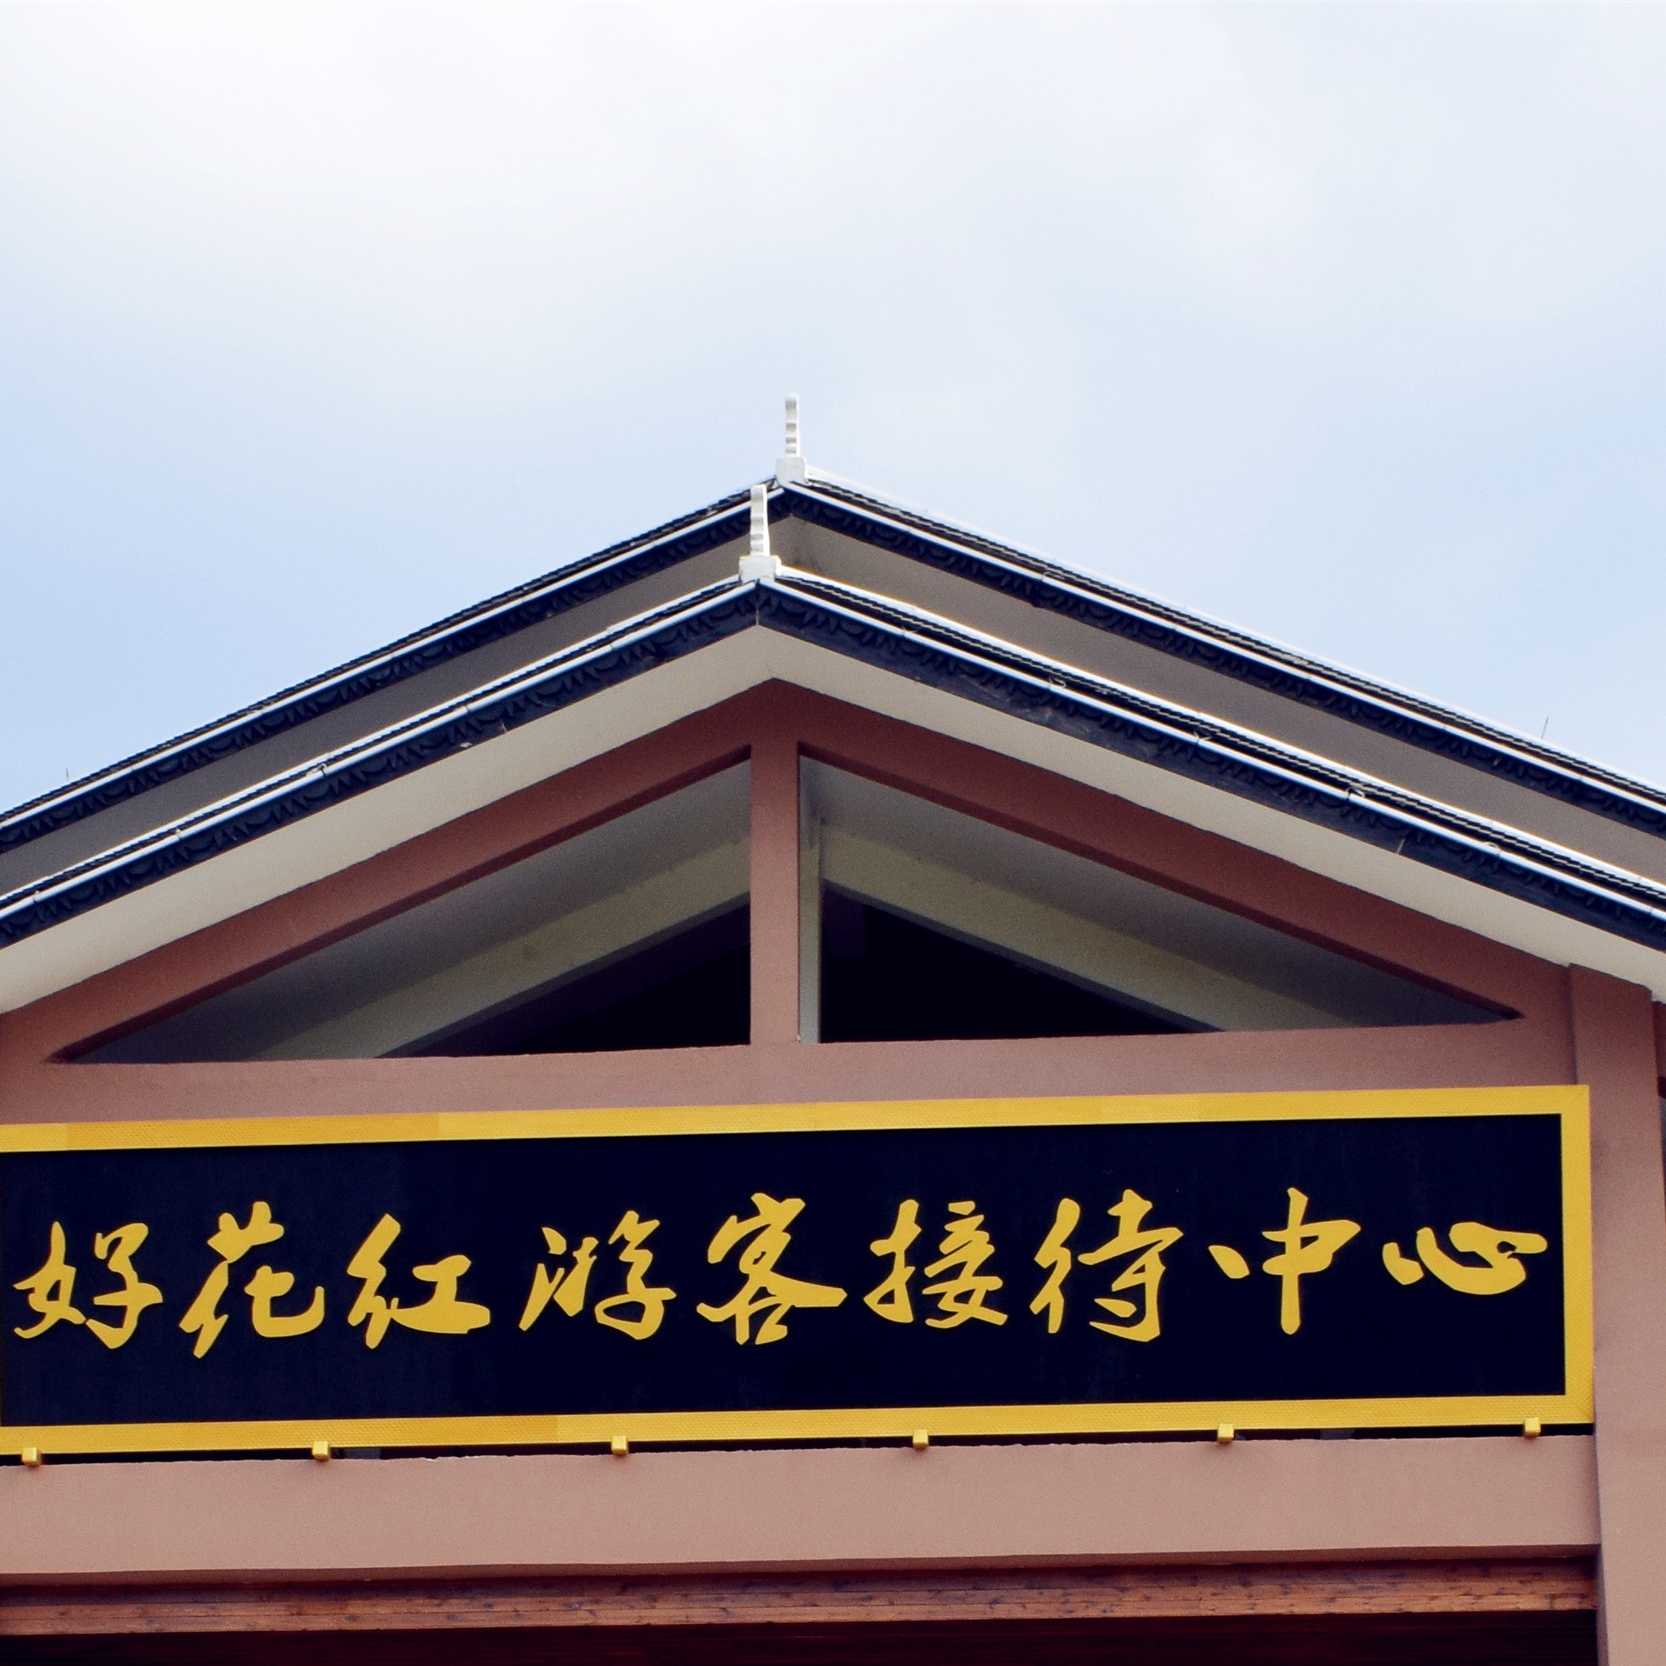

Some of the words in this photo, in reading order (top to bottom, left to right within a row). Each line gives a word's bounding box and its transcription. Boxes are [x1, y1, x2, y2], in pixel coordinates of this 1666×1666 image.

[14, 1188, 1547, 1358] 好花红游客接待中心
